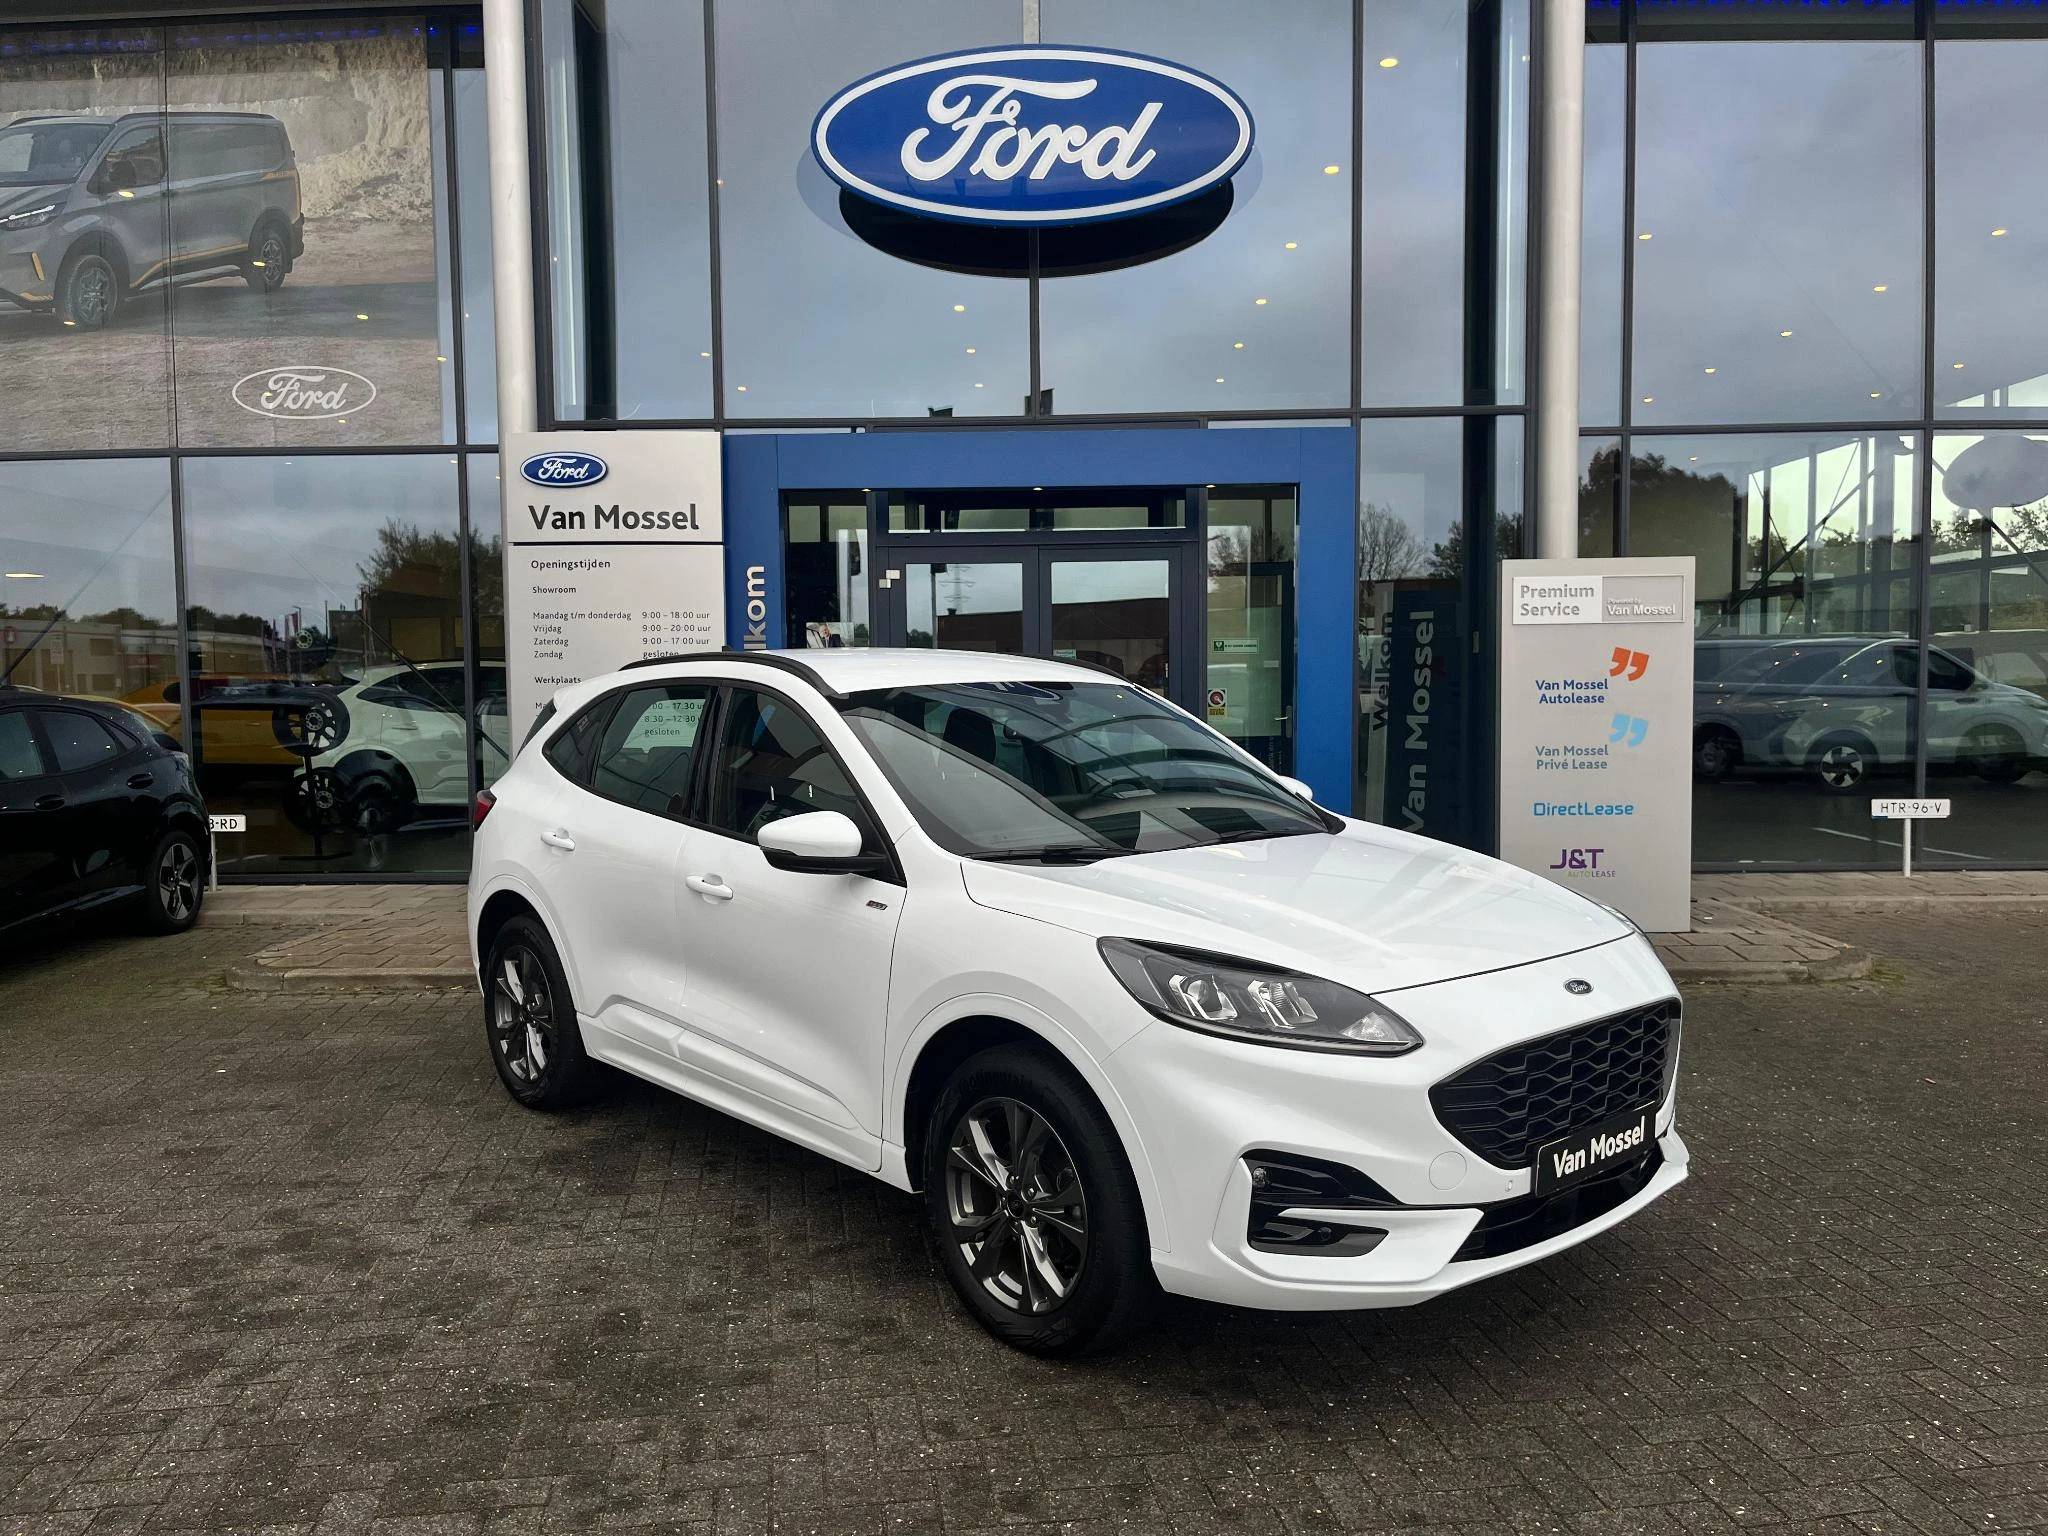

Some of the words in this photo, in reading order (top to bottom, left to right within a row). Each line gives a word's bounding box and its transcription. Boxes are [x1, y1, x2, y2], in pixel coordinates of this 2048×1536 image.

[900, 74, 1164, 182] Ford
[260, 373, 349, 410] Ford
[538, 457, 590, 480] Ford
[528, 504, 586, 531] Van
[594, 503, 700, 531] Mossel
[530, 559, 611, 572] Openingstijden
[532, 585, 577, 594] Showroom
[1520, 584, 1595, 599] Premium
[1520, 602, 1580, 616] Service
[1607, 604, 1630, 616] Van
[1633, 603, 1676, 616] Mossel
[532, 611, 568, 621] Maandag
[570, 611, 586, 620] t/m
[587, 611, 632, 621] donderdag
[532, 624, 562, 635] Vrijdag
[533, 637, 569, 648] Zaterdag
[533, 650, 563, 661] Zondag
[1372, 611, 1394, 731] Welkom
[534, 676, 582, 686] Werkplaats
[1405, 610, 1434, 750] Mossel
[1535, 679, 1560, 691] Van
[1563, 678, 1609, 690] Mossel
[1539, 692, 1605, 704] Autolease
[644, 728, 680, 738] gesloten
[1535, 745, 1560, 757] Van
[1563, 744, 1609, 756] Mossel
[1536, 758, 1569, 770] Privé
[1572, 759, 1608, 770] Lease
[1533, 801, 1634, 816] DirectLease
[1549, 848, 1604, 870] J&T
[1567, 870, 1617, 878] AUTOLEASE
[1553, 1148, 1586, 1179] Van
[1590, 1115, 1646, 1165] Mossel
